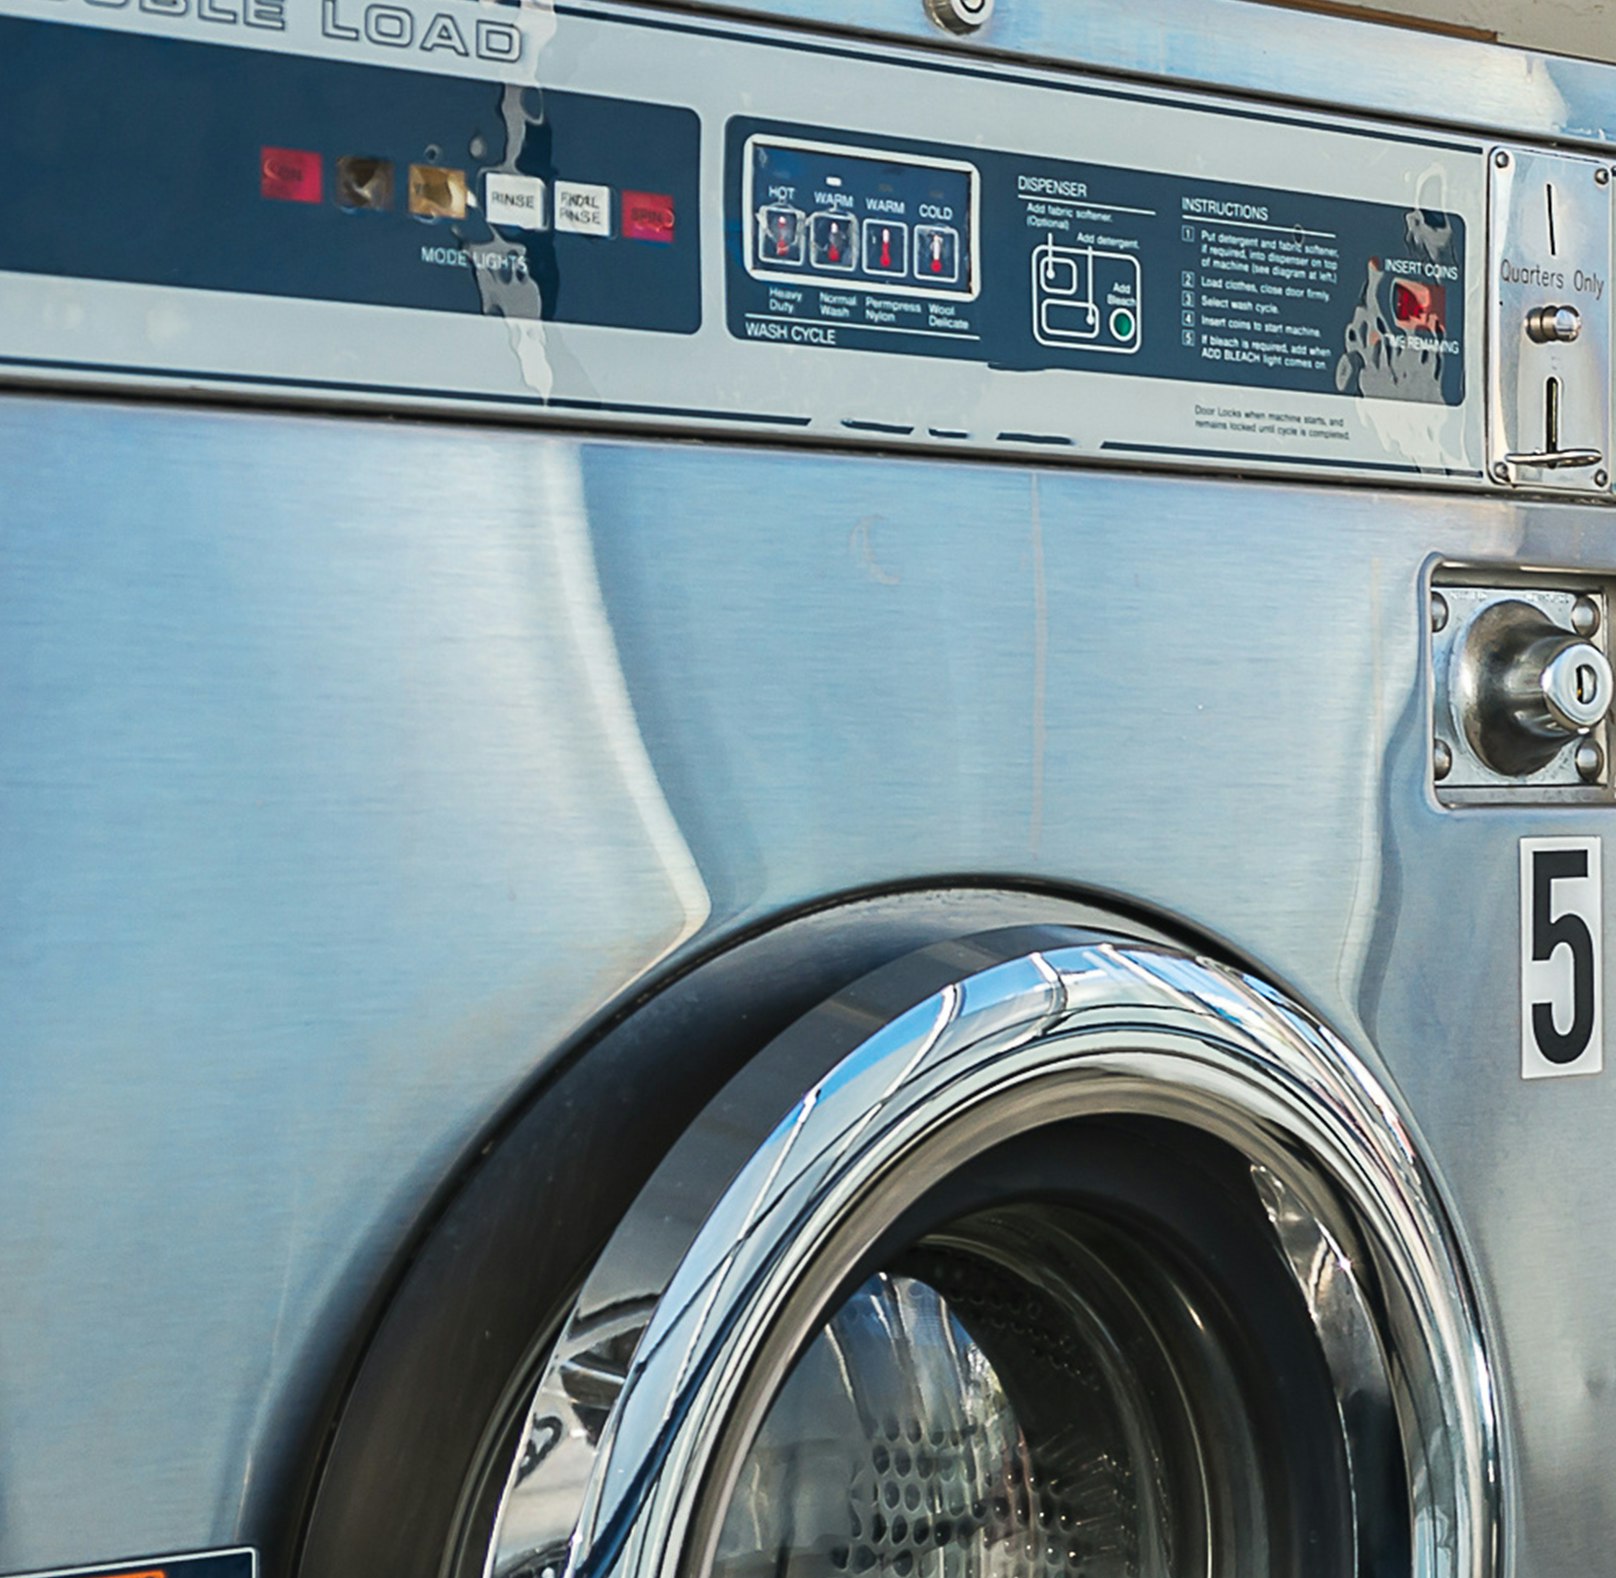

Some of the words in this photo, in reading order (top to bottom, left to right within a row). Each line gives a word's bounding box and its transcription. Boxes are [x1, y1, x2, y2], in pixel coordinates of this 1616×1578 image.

[322, 0, 522, 63] LOAD
[769, 186, 795, 200] HOT
[1018, 175, 1087, 197] DISPENSER
[492, 193, 535, 209] RINSE
[814, 191, 854, 208] WARM
[866, 198, 905, 214] WARM
[560, 208, 602, 225] RINSE
[919, 204, 953, 220] COLD
[1027, 203, 1046, 214] Add
[1048, 205, 1073, 218] fabric
[1181, 196, 1269, 221] INSTRUCTIONS
[1027, 215, 1070, 231] (Optional)
[1077, 232, 1095, 244] Add
[1201, 230, 1216, 242] Put
[1217, 232, 1259, 247] detergent
[1261, 238, 1277, 249] and
[422, 247, 469, 267] MODE
[472, 252, 527, 273] LIGHTS
[1384, 258, 1422, 275] INSERT
[1424, 261, 1459, 280] COINS
[1201, 276, 1223, 288] Load
[1260, 284, 1283, 295] close
[1285, 287, 1304, 298] door
[1500, 258, 1565, 289] Quarters
[1573, 269, 1605, 301] Only
[769, 288, 802, 303] Heavy
[1113, 282, 1131, 294] Add
[769, 299, 795, 314] Duty
[819, 292, 857, 306] Normal
[865, 296, 922, 314] Permpress
[1107, 294, 1136, 307] Bleach
[1201, 295, 1229, 309] Select
[1231, 298, 1253, 310] wash
[820, 304, 850, 318] Wash
[865, 308, 896, 323] Nylon
[928, 303, 955, 316] Wool
[928, 315, 969, 330] Delicate
[1201, 315, 1226, 327] Insert
[1228, 318, 1251, 330] coins
[1253, 320, 1262, 331] to
[1264, 322, 1283, 333] start
[746, 322, 789, 340] WASH
[791, 325, 837, 345] CYCLE
[1210, 335, 1239, 348] bleach
[1291, 345, 1307, 356] add
[1309, 346, 1332, 357] when
[1201, 347, 1222, 360] ADD
[1224, 349, 1261, 363] BLEACH
[1263, 353, 1282, 367] light
[1284, 357, 1313, 369] comes
[1532, 849, 1595, 1064] 5
